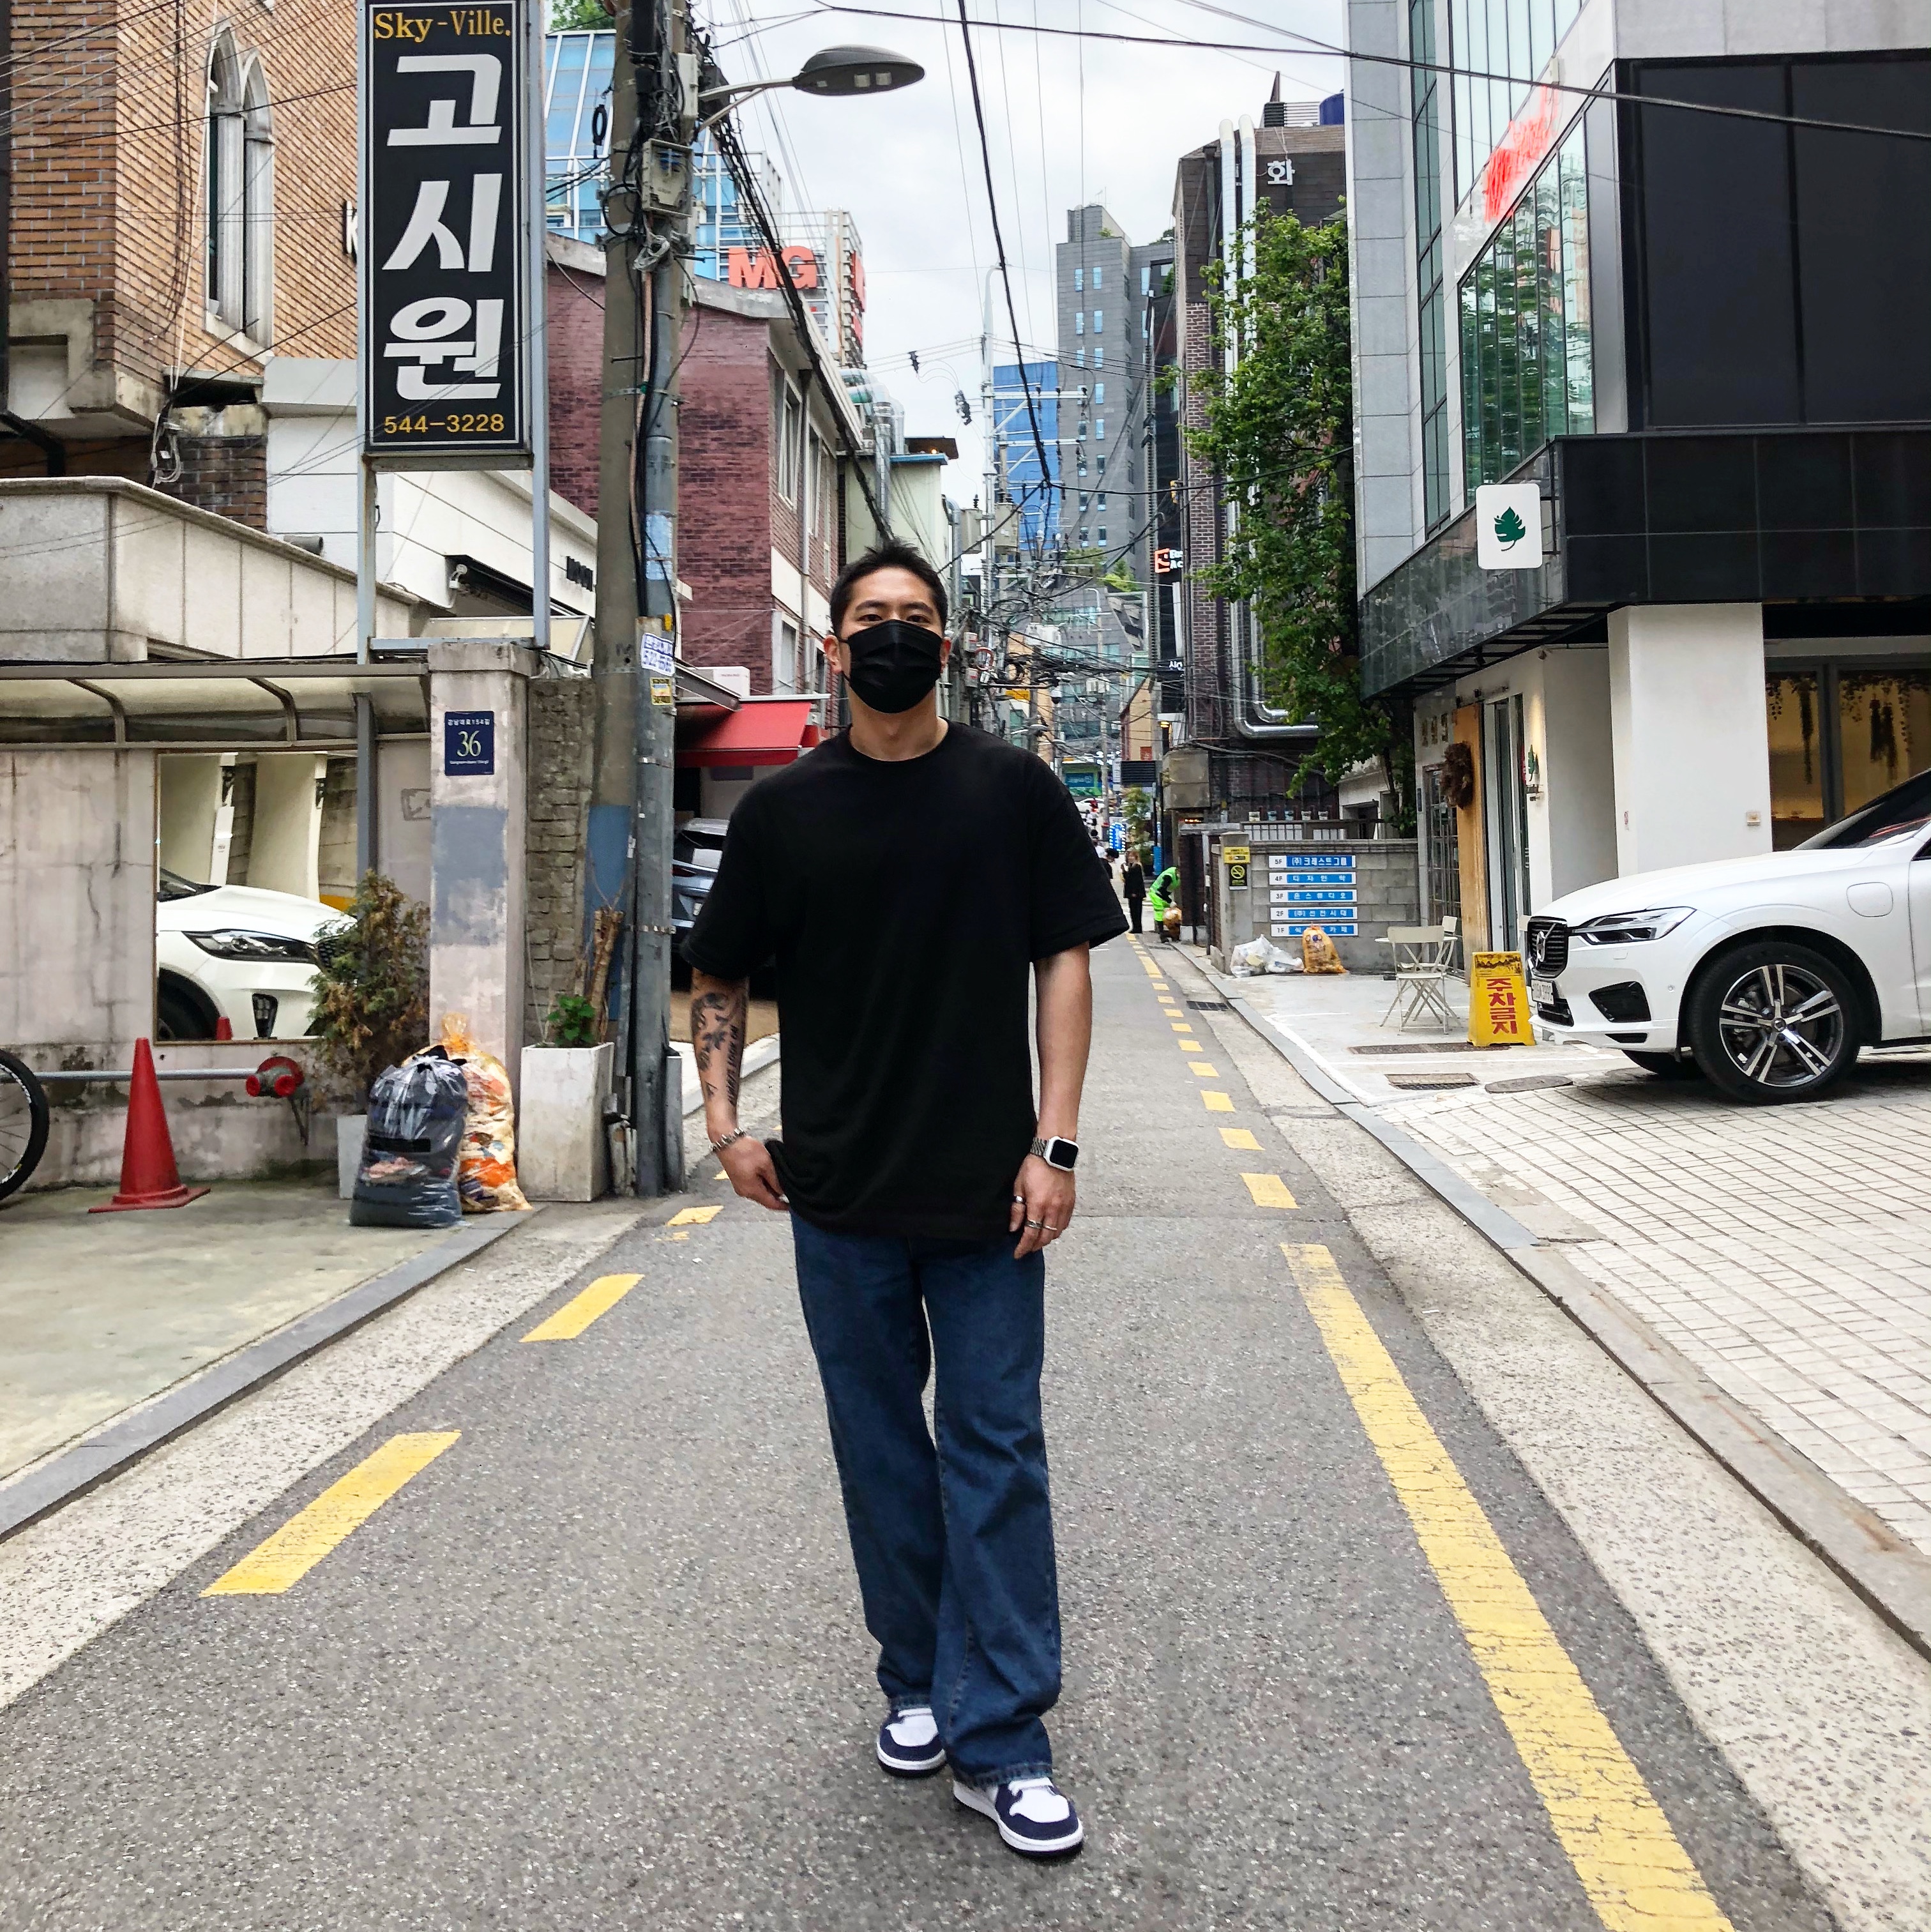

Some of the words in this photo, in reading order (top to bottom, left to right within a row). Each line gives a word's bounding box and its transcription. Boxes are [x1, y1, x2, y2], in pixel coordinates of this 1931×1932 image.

[1267, 158, 1296, 186] 화
[382, 54, 504, 400] 고시원
[728, 245, 817, 289] MG
[384, 414, 504, 434] 544-3228
[457, 730, 481, 757] 36
[1486, 978, 1518, 1034] 주차금지
